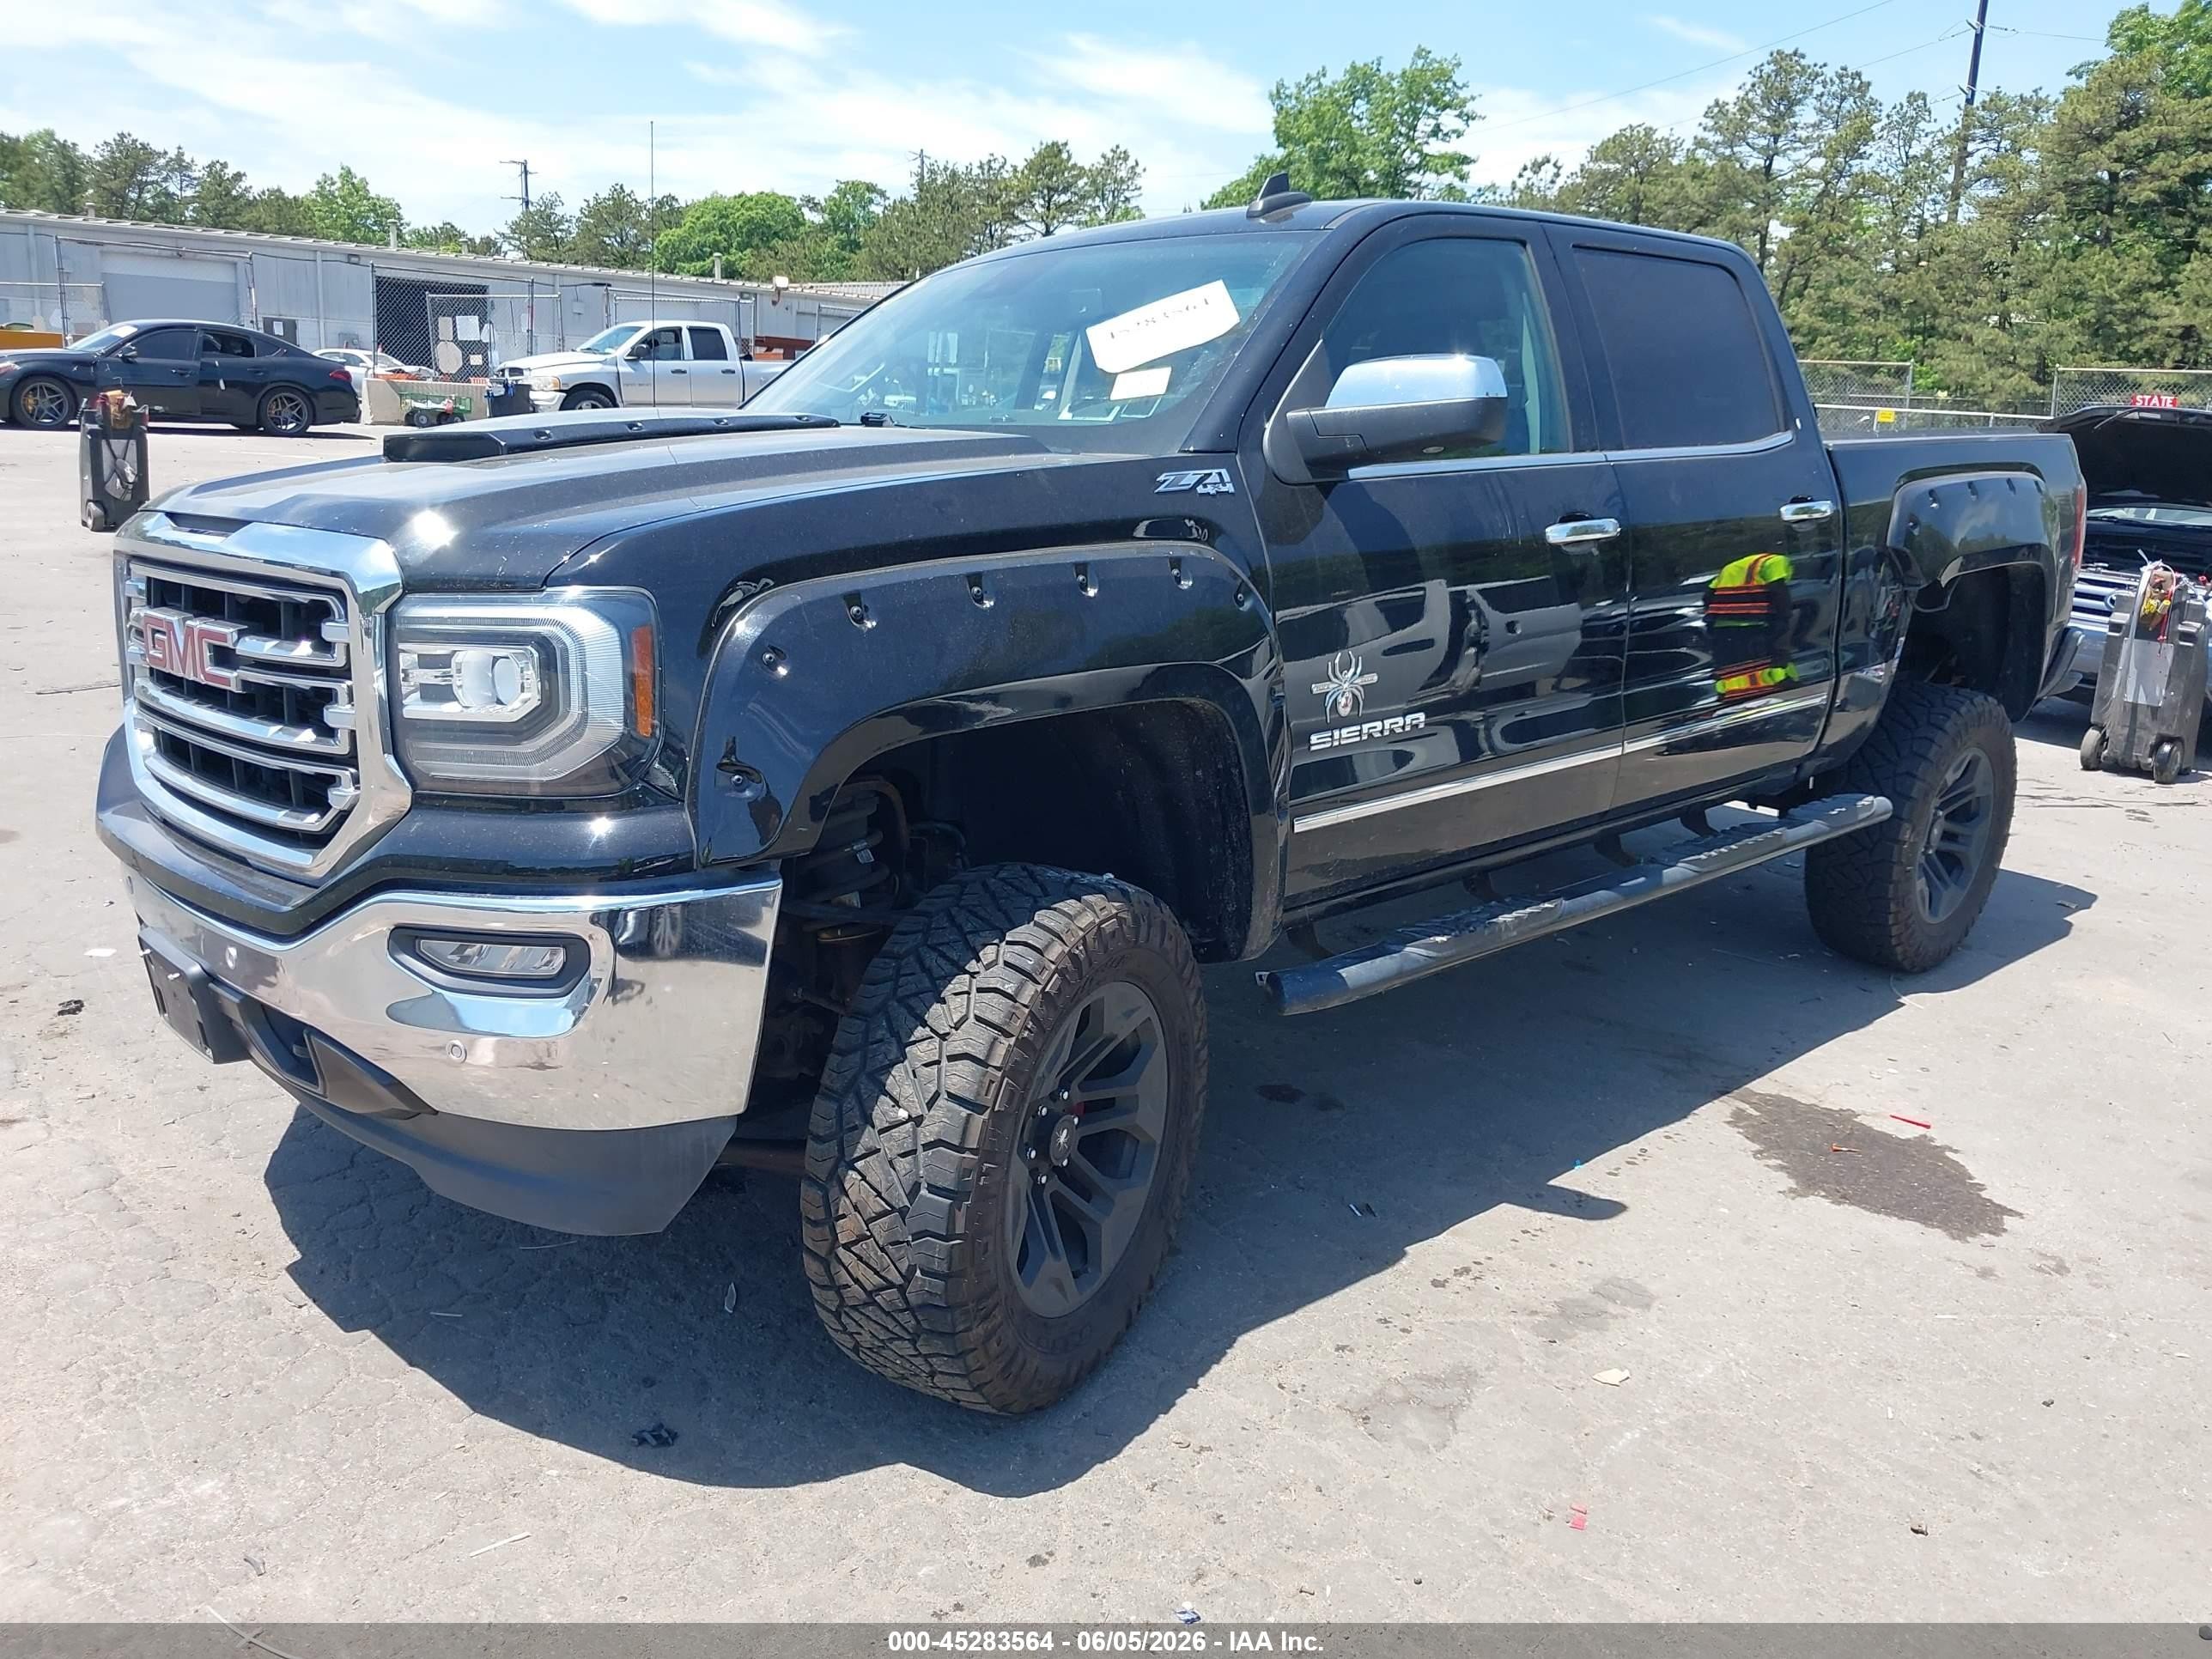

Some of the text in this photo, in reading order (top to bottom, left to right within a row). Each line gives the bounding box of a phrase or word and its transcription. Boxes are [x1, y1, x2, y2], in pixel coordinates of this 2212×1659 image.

[2135, 394, 2175, 408] STATE
[1154, 469, 1231, 494] Z71
[143, 610, 241, 693] GMC
[1310, 712, 1426, 751] SIERRA
